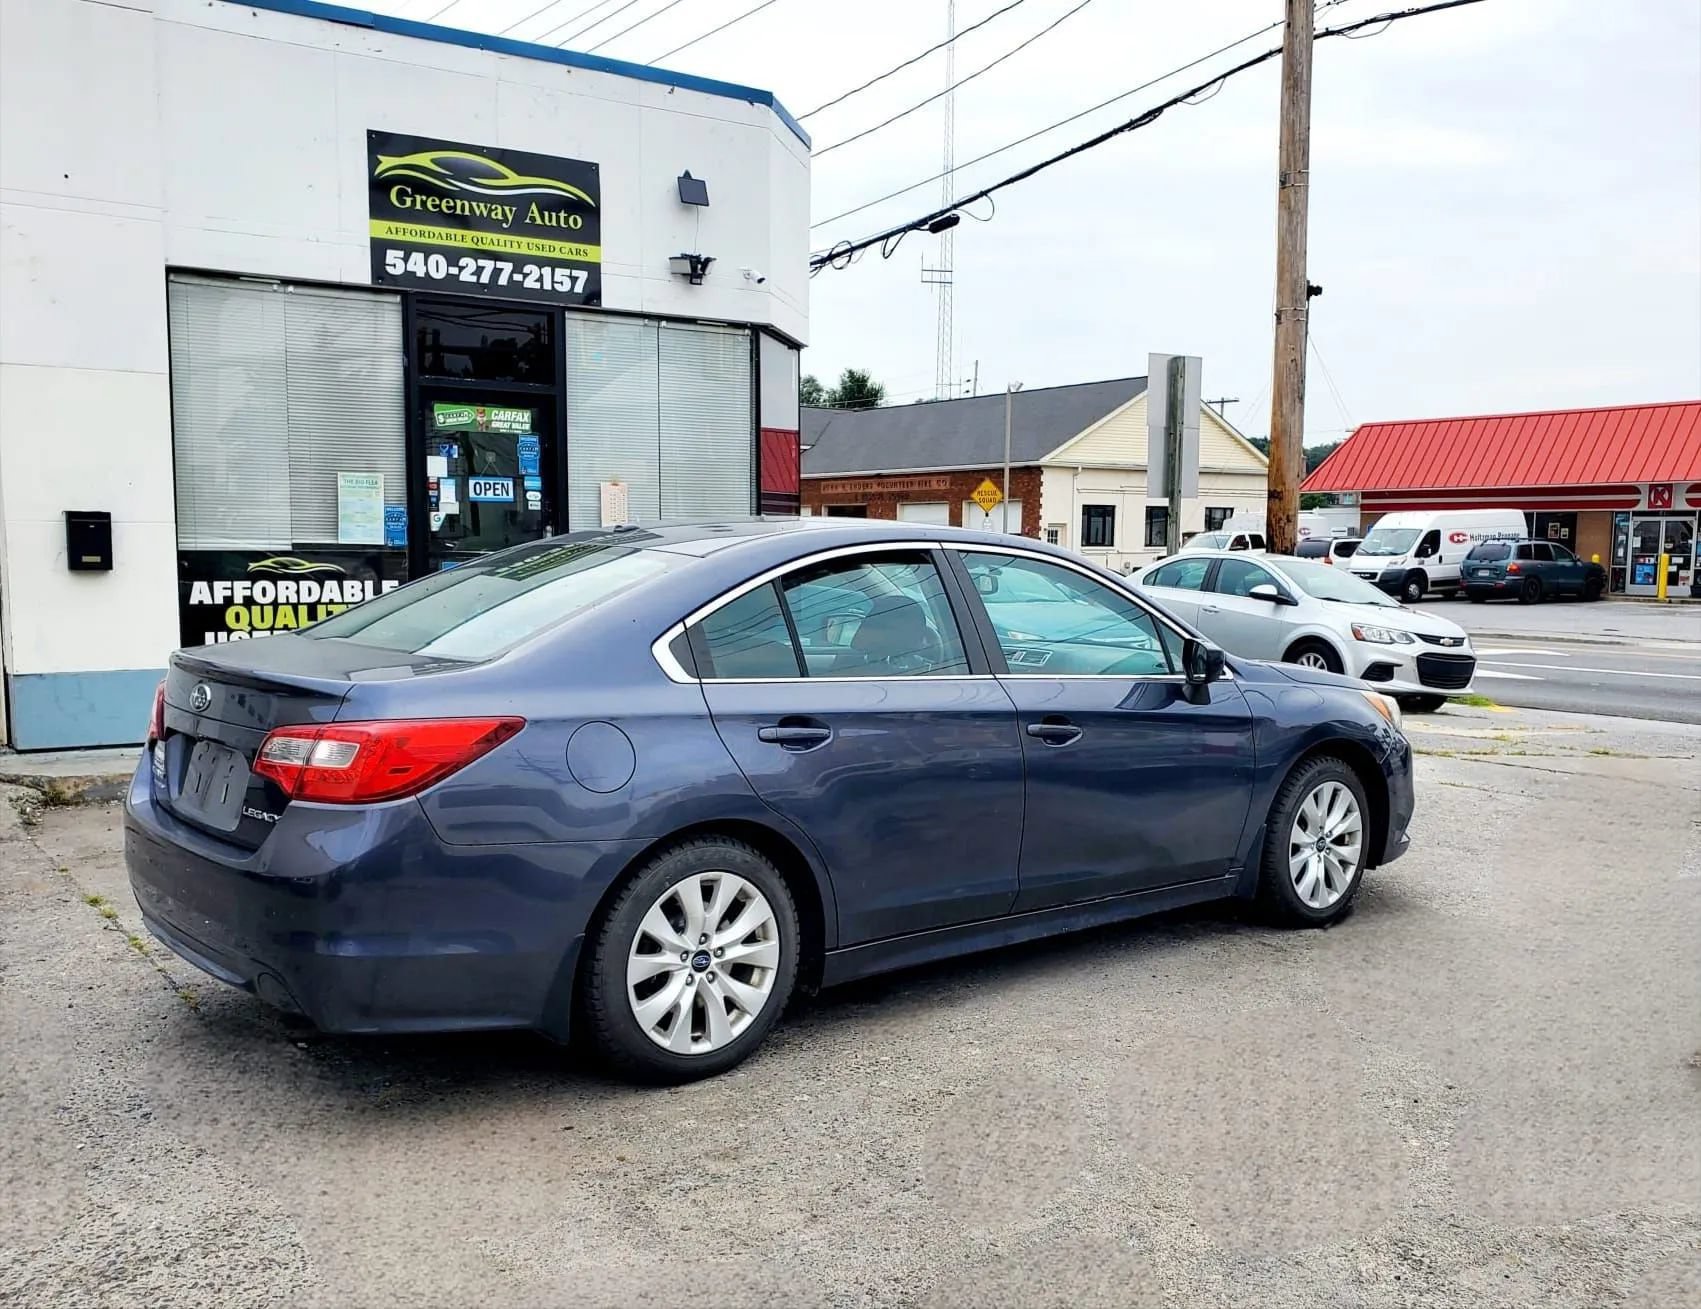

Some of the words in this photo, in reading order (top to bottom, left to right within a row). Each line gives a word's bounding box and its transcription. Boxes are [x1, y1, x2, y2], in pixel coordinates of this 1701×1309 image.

[389, 185, 517, 229] Greenway
[524, 202, 583, 230] Auto
[385, 225, 468, 244] AFFORDABLE
[471, 235, 523, 251] QUALITY
[526, 242, 556, 254] USED
[559, 246, 589, 258] CARS
[385, 249, 589, 294] 540-277-2157
[491, 410, 530, 422] CARFAX
[473, 481, 510, 497] OPEN
[225, 605, 350, 632] QUALIT
[242, 806, 283, 822] LEGACY
